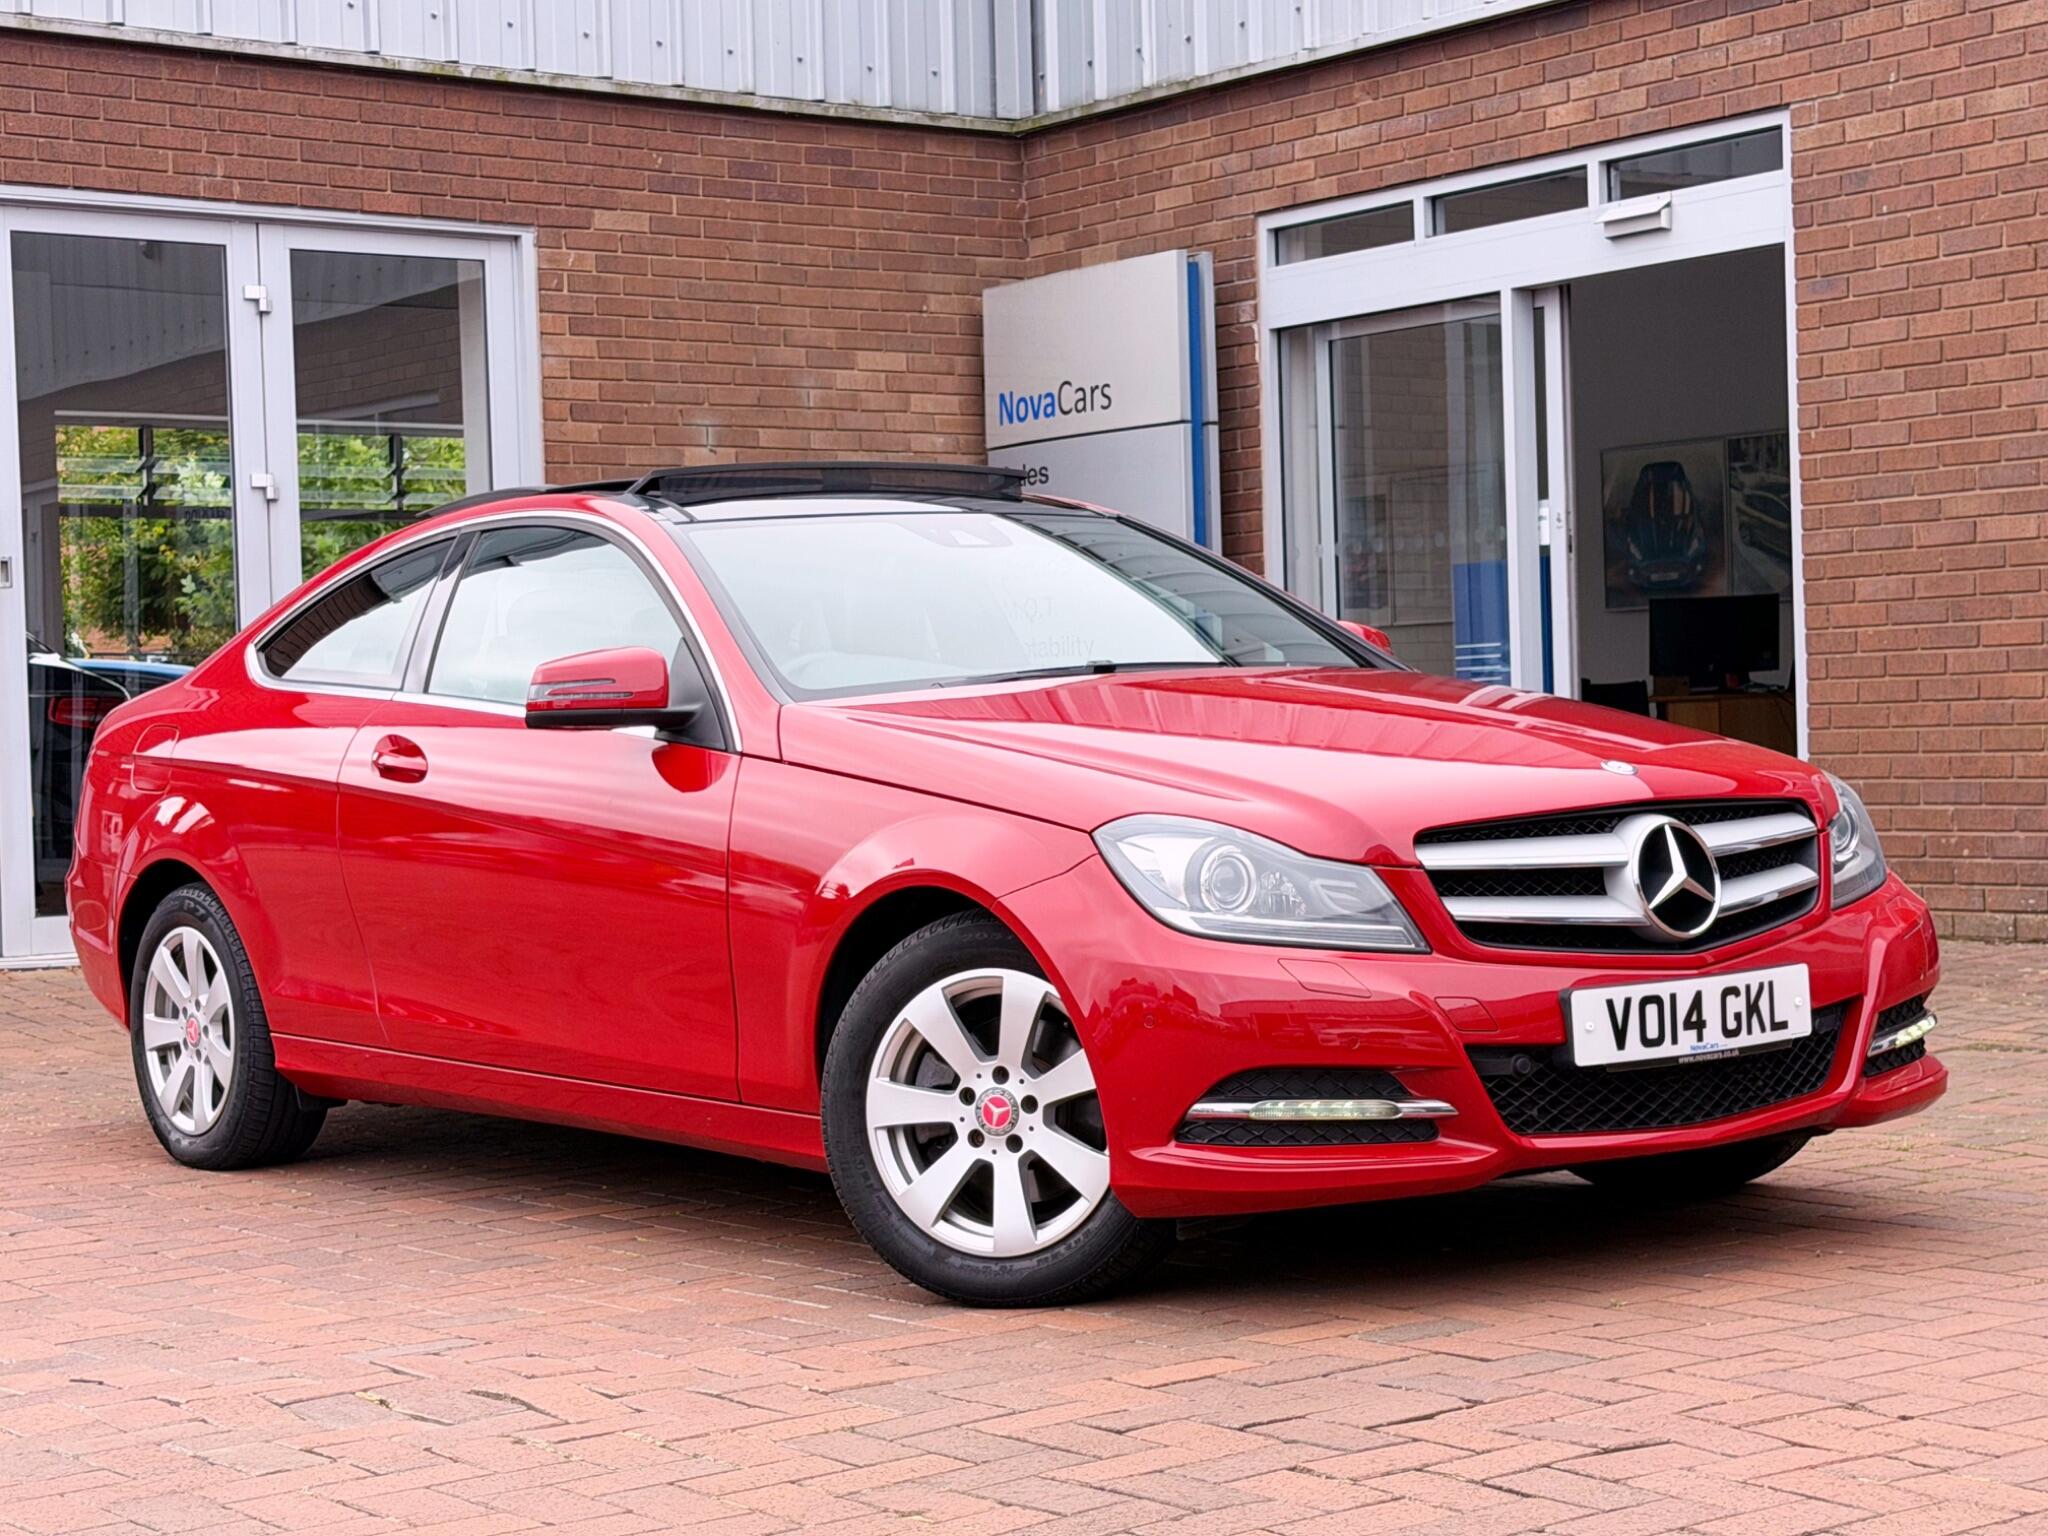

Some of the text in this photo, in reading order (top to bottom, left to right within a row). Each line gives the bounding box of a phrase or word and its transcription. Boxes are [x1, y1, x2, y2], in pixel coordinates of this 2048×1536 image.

[998, 380, 1112, 426] NovaCars
[1605, 979, 1789, 1051] VO14 GKL
